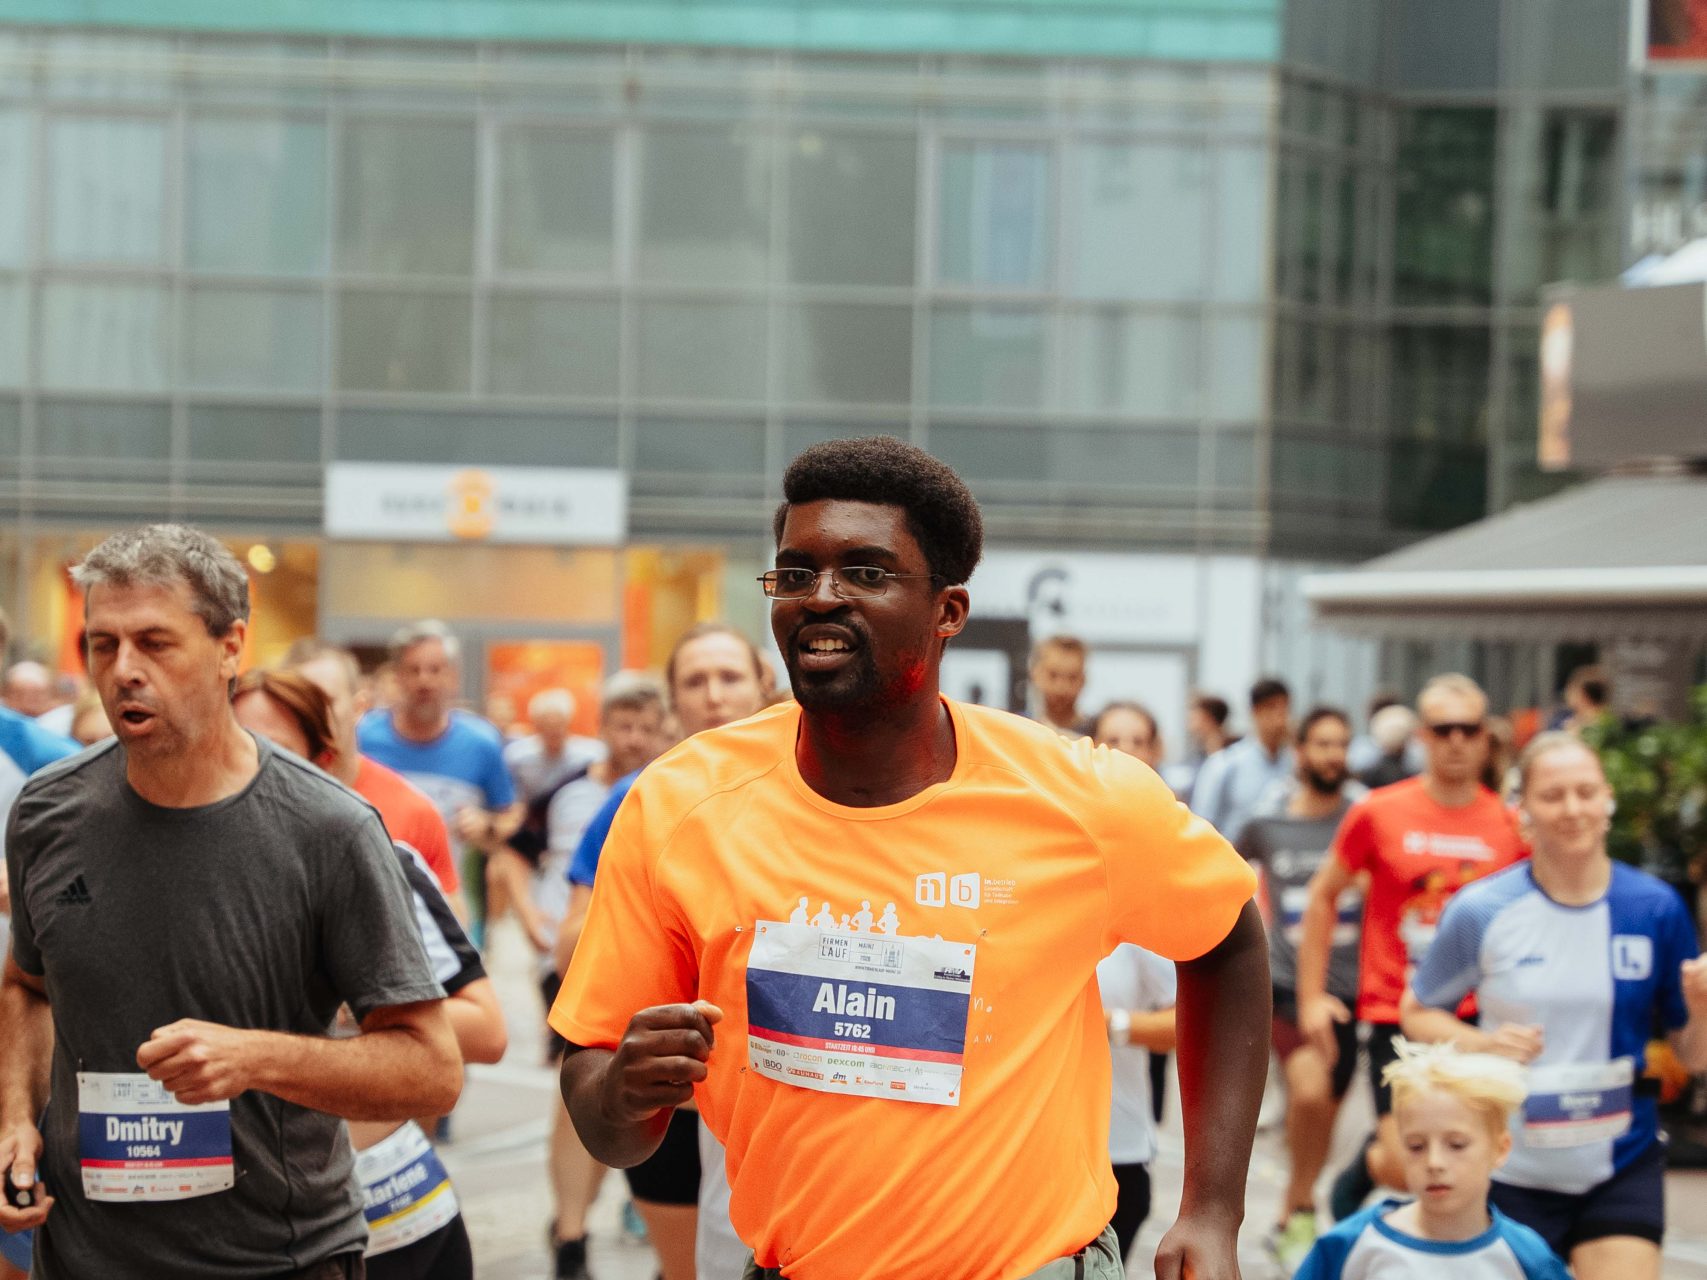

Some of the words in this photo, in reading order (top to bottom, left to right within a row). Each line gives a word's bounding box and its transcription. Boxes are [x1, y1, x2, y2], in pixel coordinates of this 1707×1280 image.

[822, 937, 848, 947] FIRMEN
[821, 945, 847, 959] LAUF
[812, 982, 896, 1021] Alain
[834, 1022, 872, 1039] 5762
[764, 1058, 783, 1071] BDO
[833, 1072, 847, 1081] dm
[106, 1115, 184, 1146] Dmitry
[126, 1145, 161, 1158] 10564
